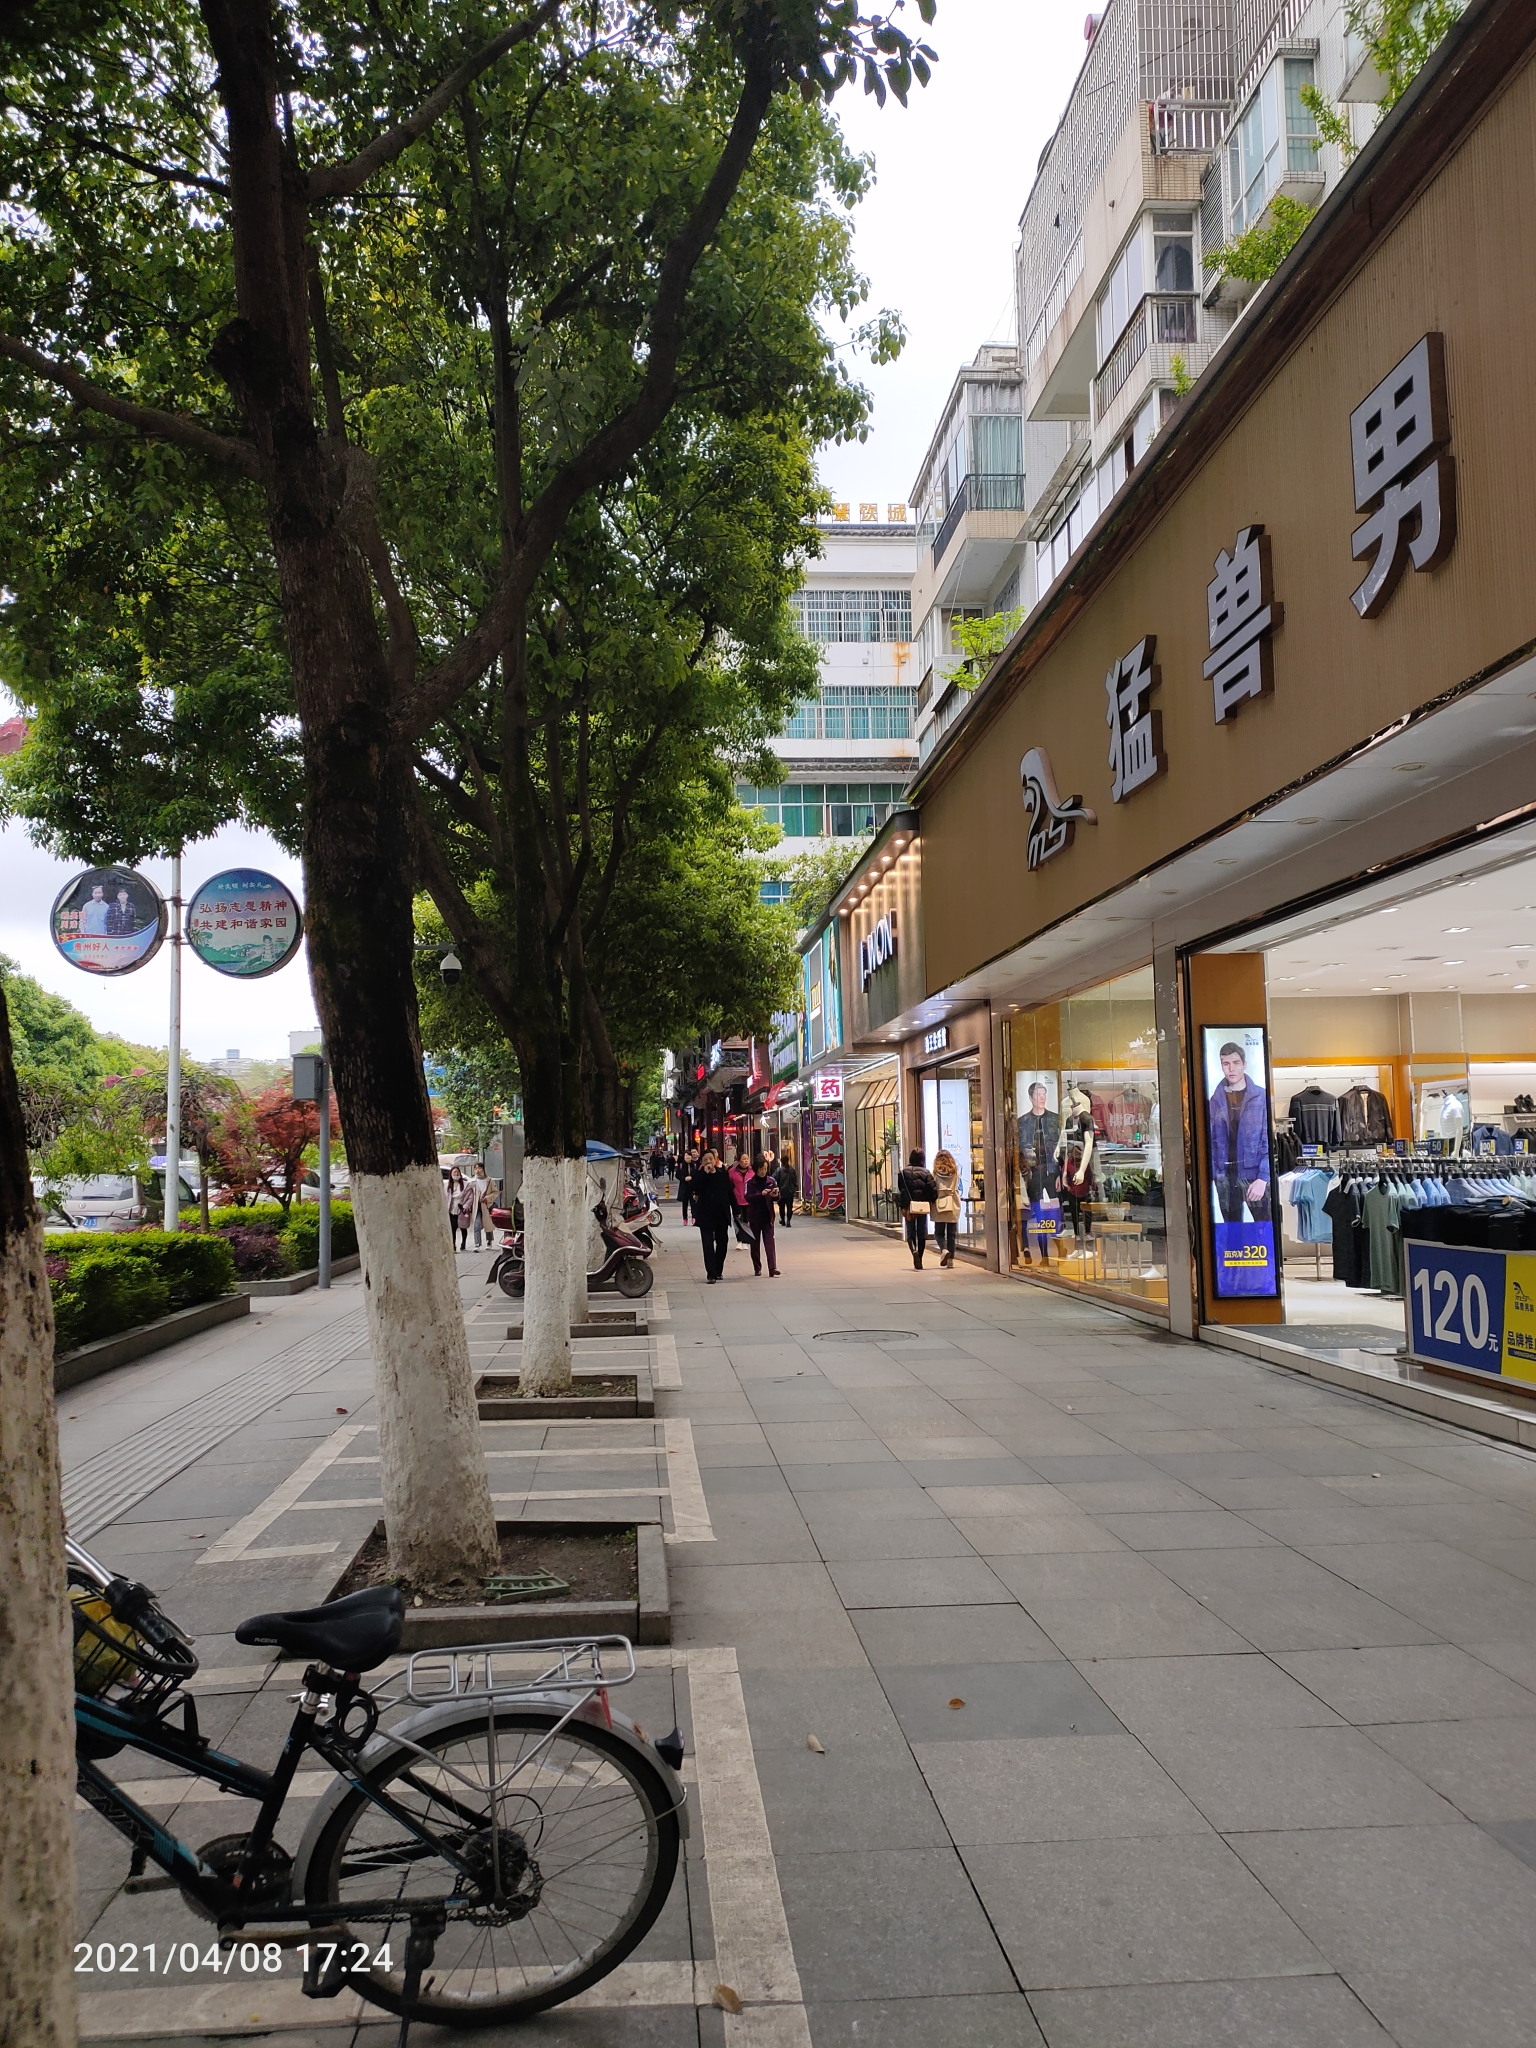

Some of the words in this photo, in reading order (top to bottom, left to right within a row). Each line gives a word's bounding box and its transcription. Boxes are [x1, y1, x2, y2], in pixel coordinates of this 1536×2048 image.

[1105, 331, 1456, 805] 猛兽男
[199, 901, 287, 913] 弘扬志愿精神
[199, 918, 287, 930] 共建和谐家园
[820, 1078, 840, 1098] 药
[1431, 1141, 1442, 1151] 50
[1515, 1141, 1524, 1150] 50
[1508, 1330, 1536, 1351] 品牌推
